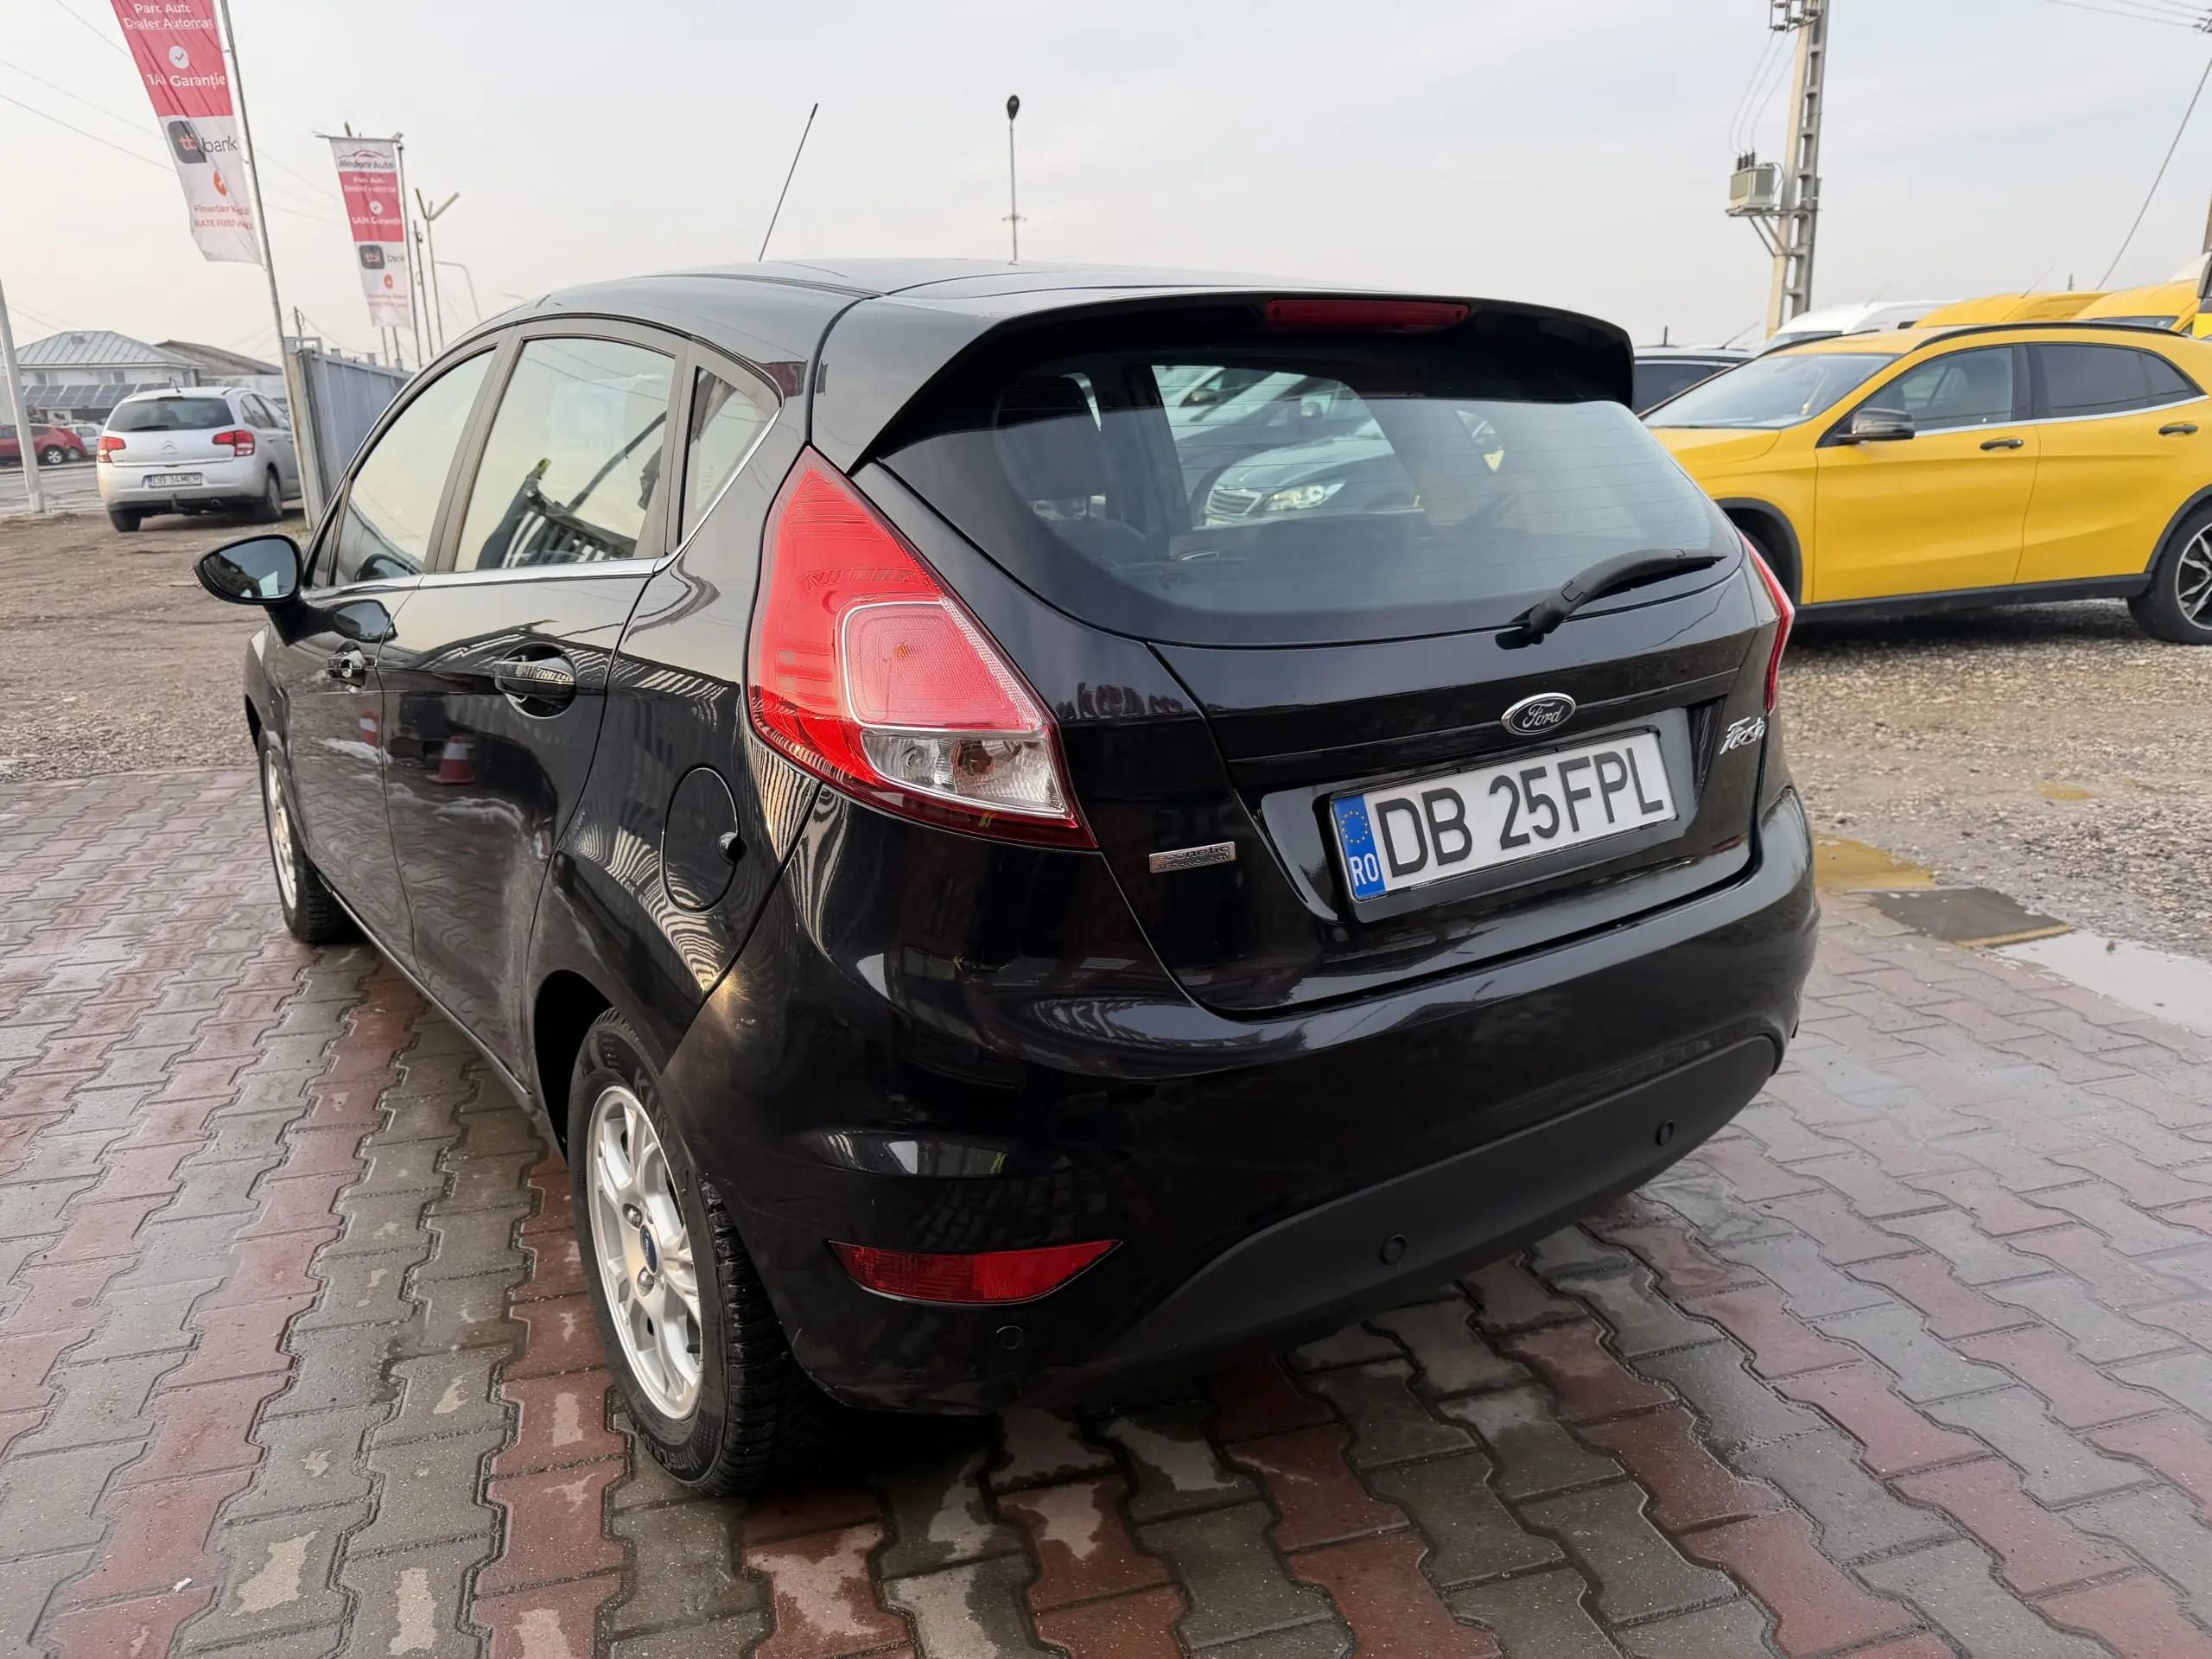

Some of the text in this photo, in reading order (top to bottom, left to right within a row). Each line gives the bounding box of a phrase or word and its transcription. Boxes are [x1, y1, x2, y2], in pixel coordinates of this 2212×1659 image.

[134, 3, 162, 14] Parc
[169, 73, 226, 90] Garanție
[201, 135, 238, 153] bank
[1522, 702, 1564, 728] Ford
[1375, 787, 1473, 877] DB
[1350, 855, 1380, 887] RO
